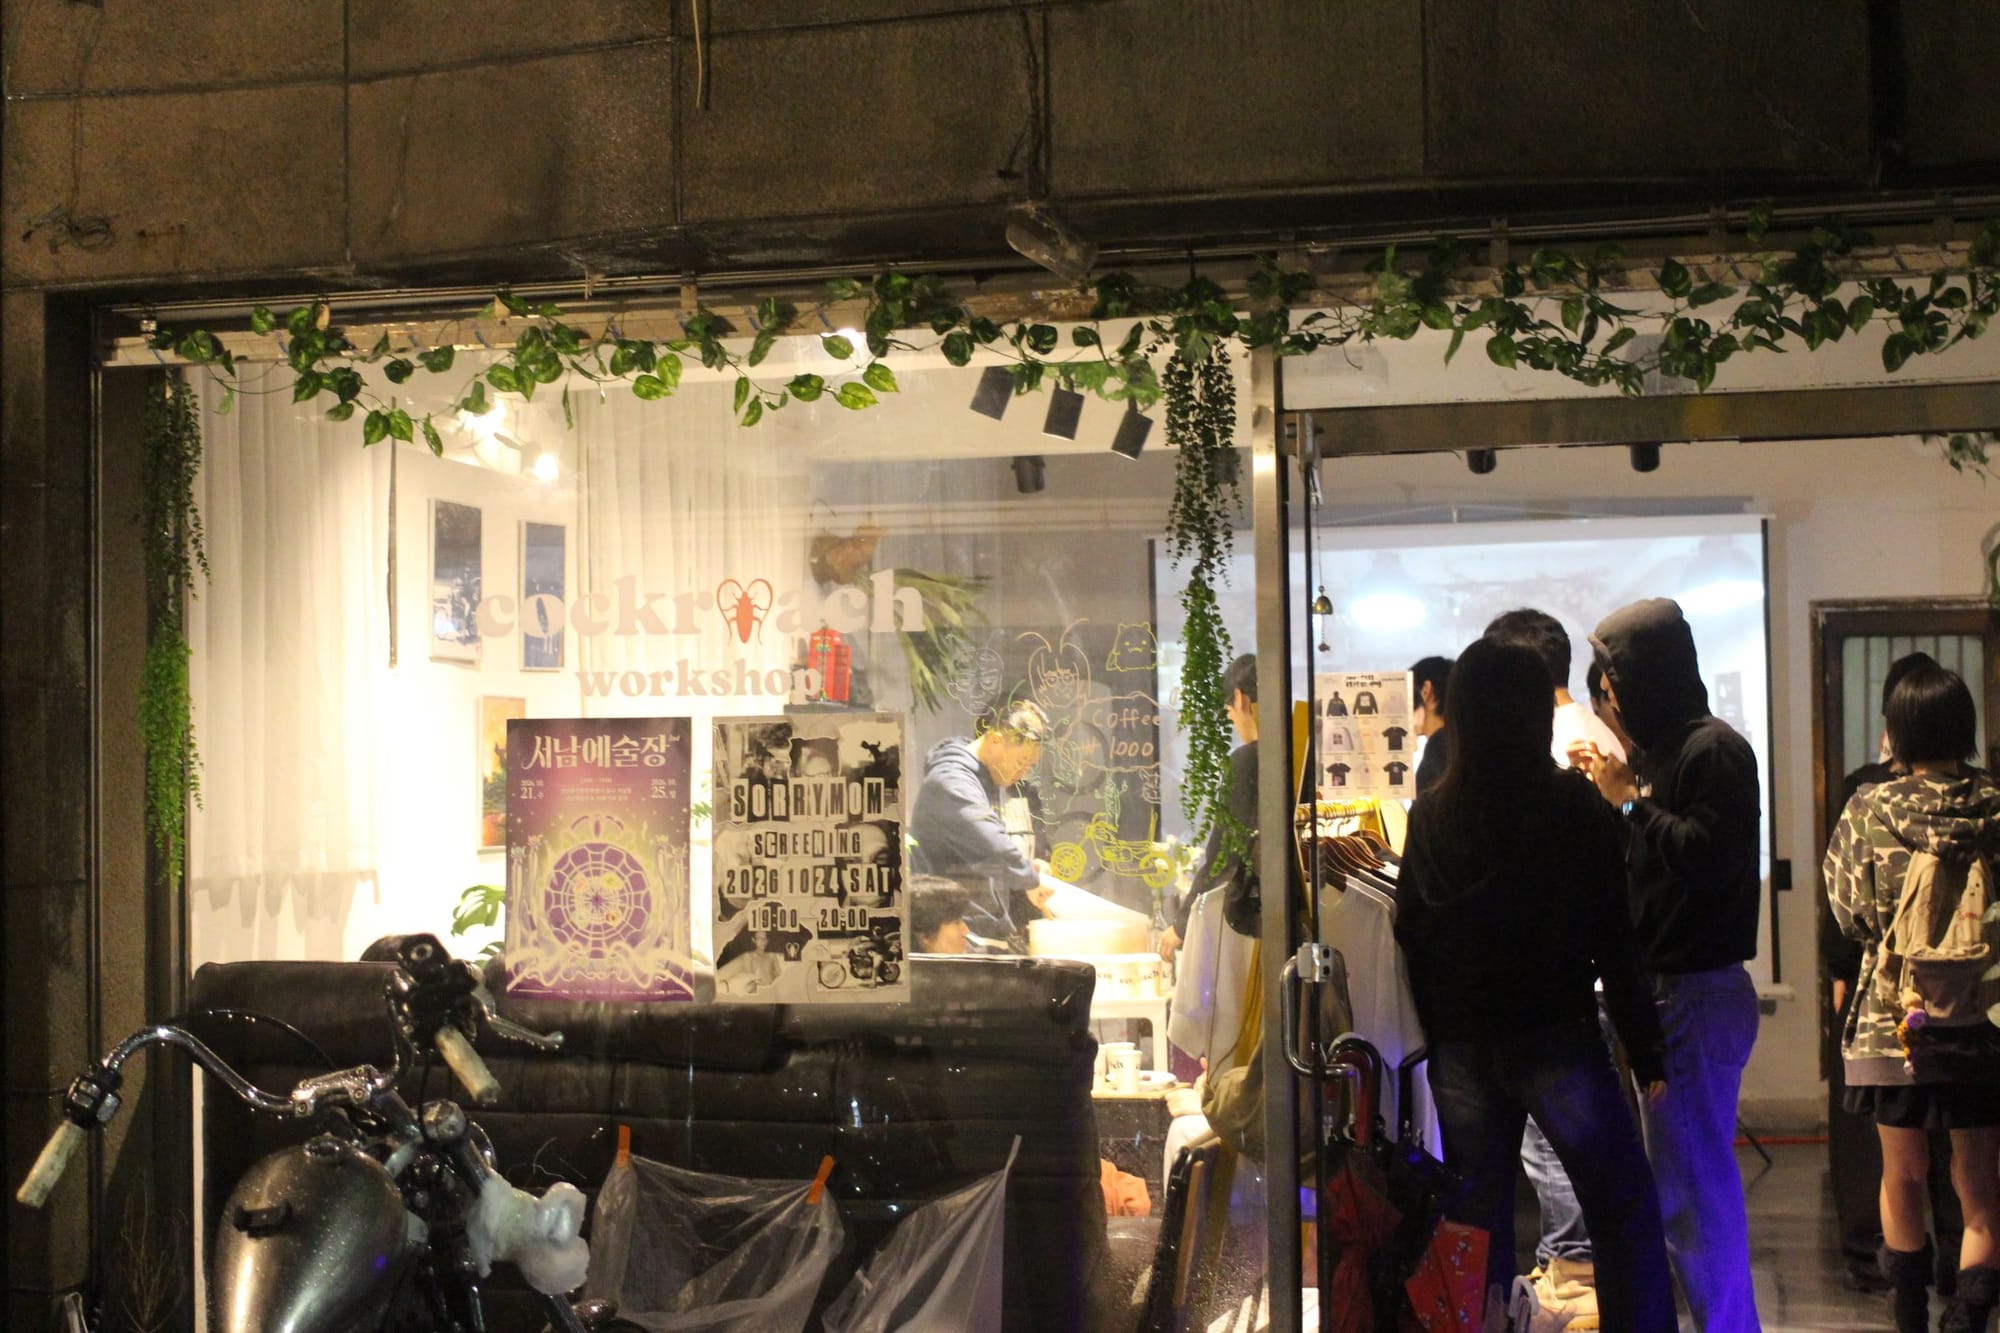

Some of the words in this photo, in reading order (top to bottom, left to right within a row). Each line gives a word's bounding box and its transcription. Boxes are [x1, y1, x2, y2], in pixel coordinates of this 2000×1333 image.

[475, 568, 926, 644] cockrach
[575, 658, 822, 705] workshop
[1092, 707, 1161, 729] Coffee
[520, 734, 671, 770] 서남예술장
[1109, 736, 1154, 760] 1000
[734, 782, 882, 817] SORRYMOM
[754, 831, 861, 857] SCREENING
[726, 867, 779, 895] 2026
[787, 866, 840, 895] 1024
[850, 866, 891, 894] SAT
[751, 908, 798, 930] 19:00
[820, 908, 867, 928] 20:00
